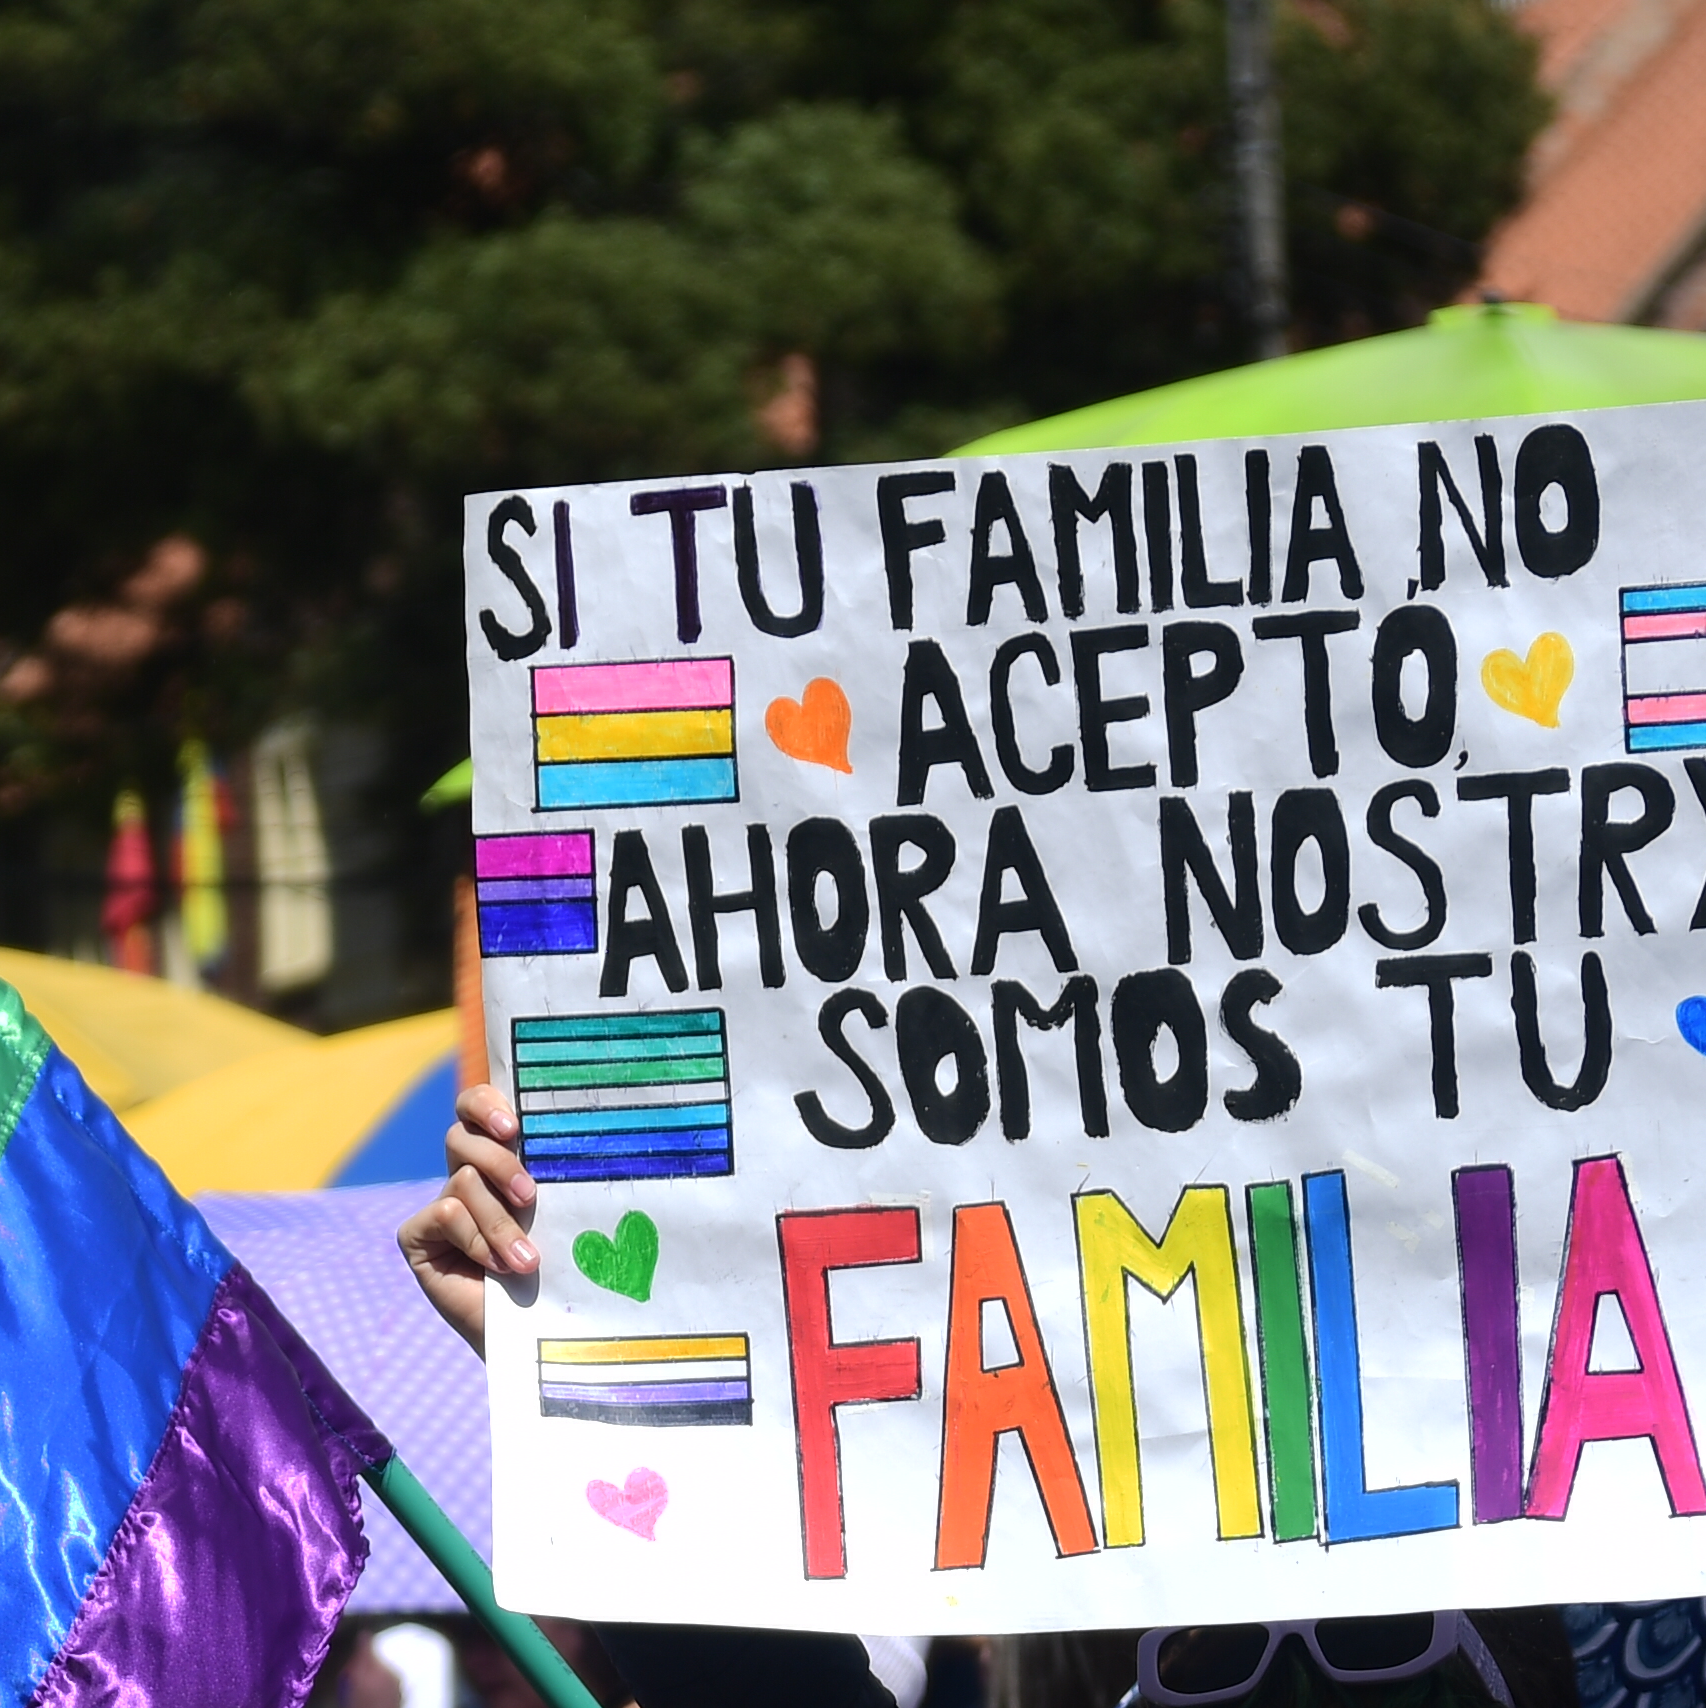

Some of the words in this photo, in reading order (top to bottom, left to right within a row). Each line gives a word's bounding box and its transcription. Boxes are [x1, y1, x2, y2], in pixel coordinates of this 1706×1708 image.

[479, 494, 579, 661] SI
[630, 479, 825, 644] TU
[875, 446, 1365, 631] FAMILIA
[1416, 424, 1599, 591] NO
[599, 806, 1079, 997] AHORA
[794, 968, 1301, 1149] SOMOS
[1376, 951, 1612, 1119] TU
